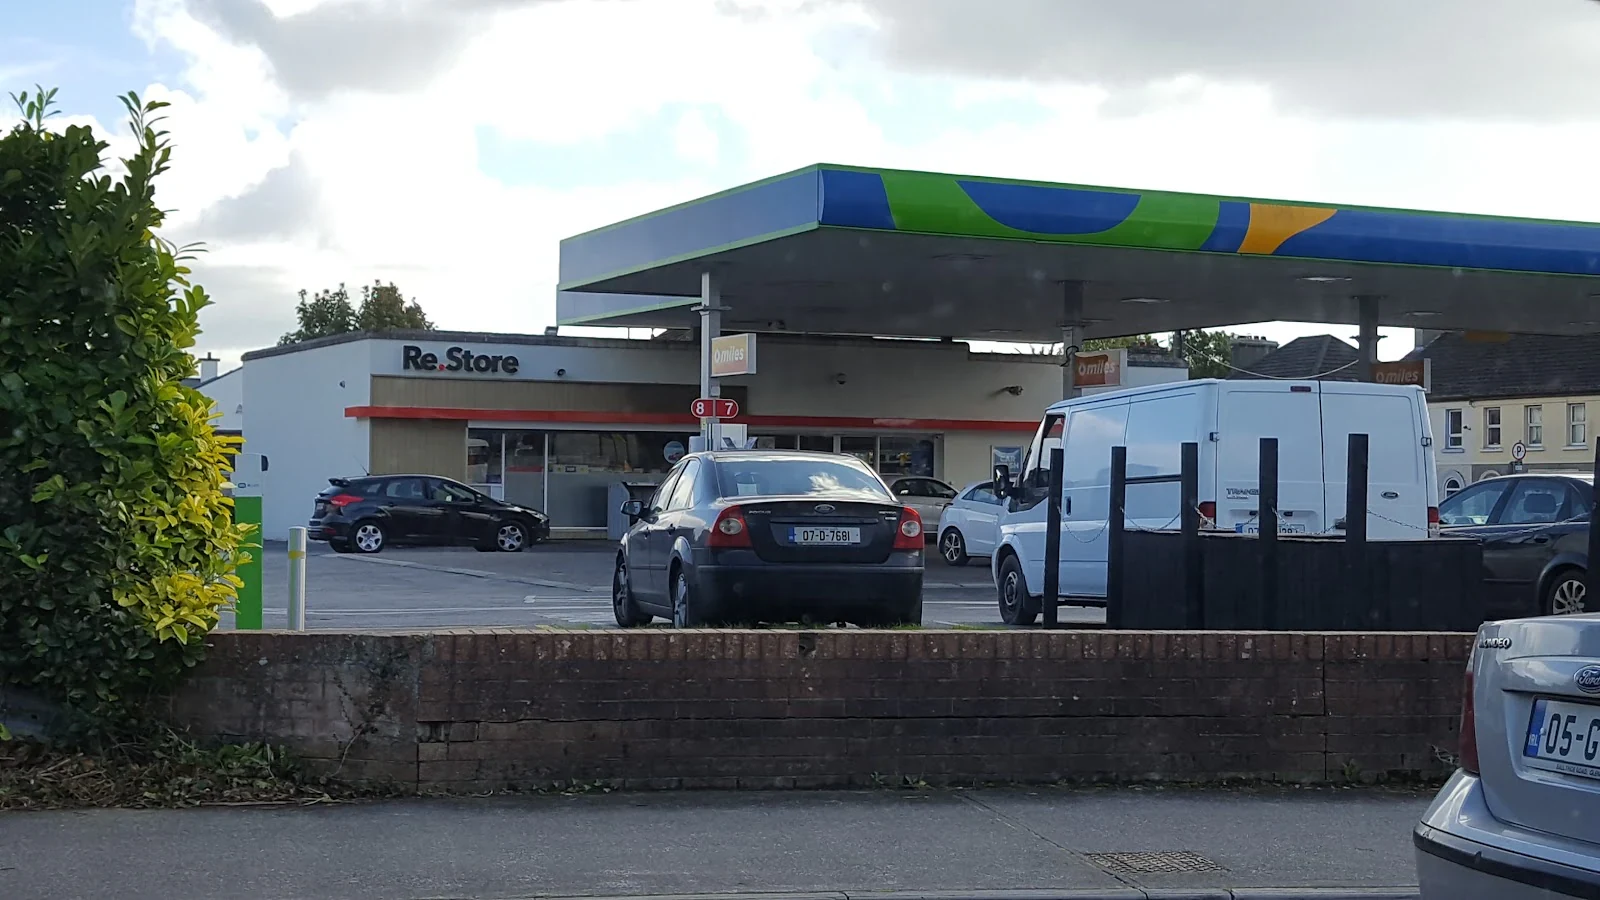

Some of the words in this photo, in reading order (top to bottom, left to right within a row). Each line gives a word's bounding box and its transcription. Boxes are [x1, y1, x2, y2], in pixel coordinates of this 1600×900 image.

[402, 345, 519, 373] Re.Store
[695, 402, 705, 415] 8
[725, 402, 734, 415] 7
